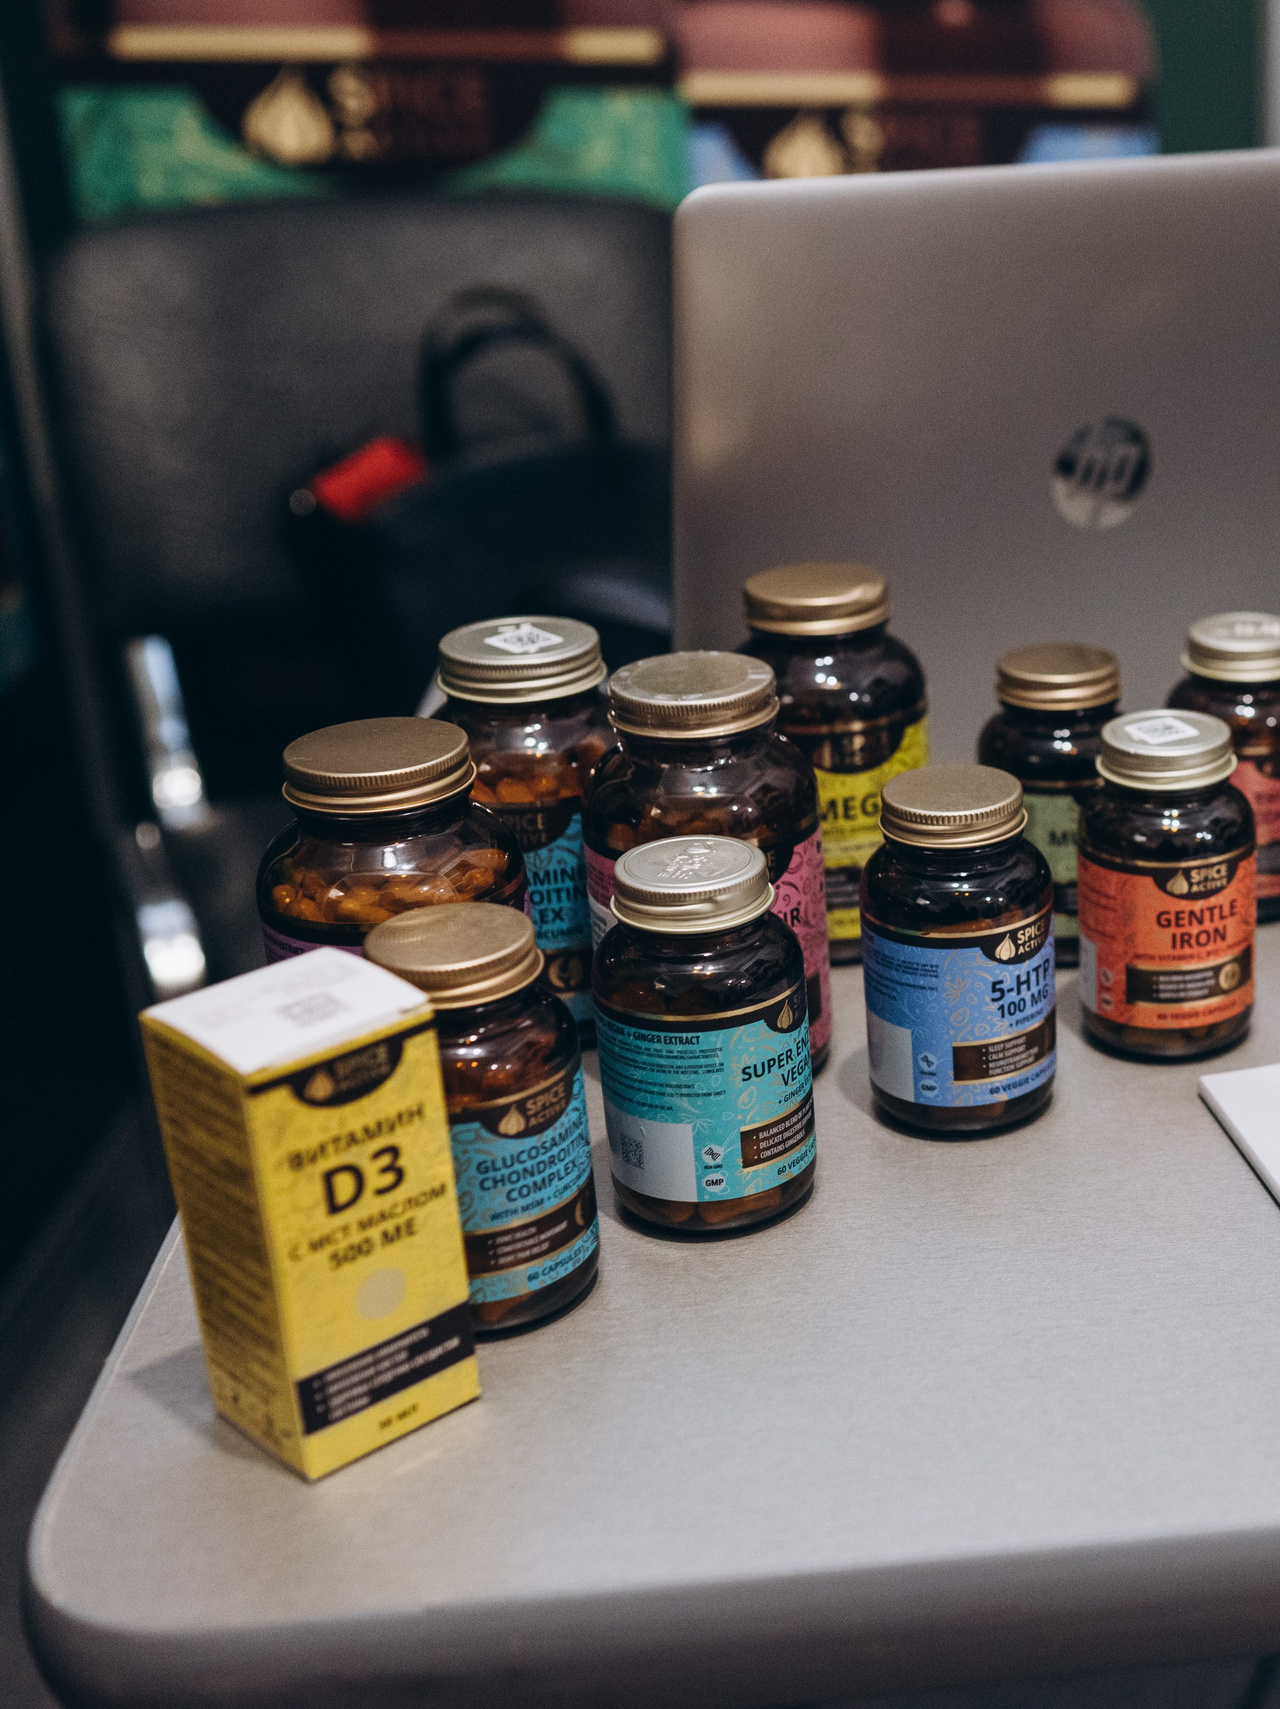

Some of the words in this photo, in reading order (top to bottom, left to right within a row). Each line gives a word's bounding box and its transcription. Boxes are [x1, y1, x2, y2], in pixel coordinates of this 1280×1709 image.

[1190, 863, 1228, 883] SPICE
[1156, 899, 1237, 928] GENTLE
[1017, 918, 1045, 944] SPICE
[1171, 925, 1227, 949] IRON
[991, 958, 1050, 1002] 5-HTP
[997, 998, 1026, 1019] 100
[1031, 983, 1049, 1007] MG
[633, 1031, 662, 1043] GINGER
[664, 1036, 700, 1045] EXTRACT
[742, 1048, 794, 1081] SUPER
[526, 1081, 565, 1116] SPICE
[784, 1083, 805, 1102] GINGER
[759, 1123, 785, 1139] BALANCED
[760, 1135, 783, 1149] DELICATE
[760, 1143, 785, 1158] CONTAINS
[777, 1166, 786, 1175] 60
[788, 1151, 808, 1169] VEGGIE
[322, 1144, 405, 1217] D3
[506, 1158, 578, 1202] COMPLEX
[705, 1179, 724, 1187] GMP
